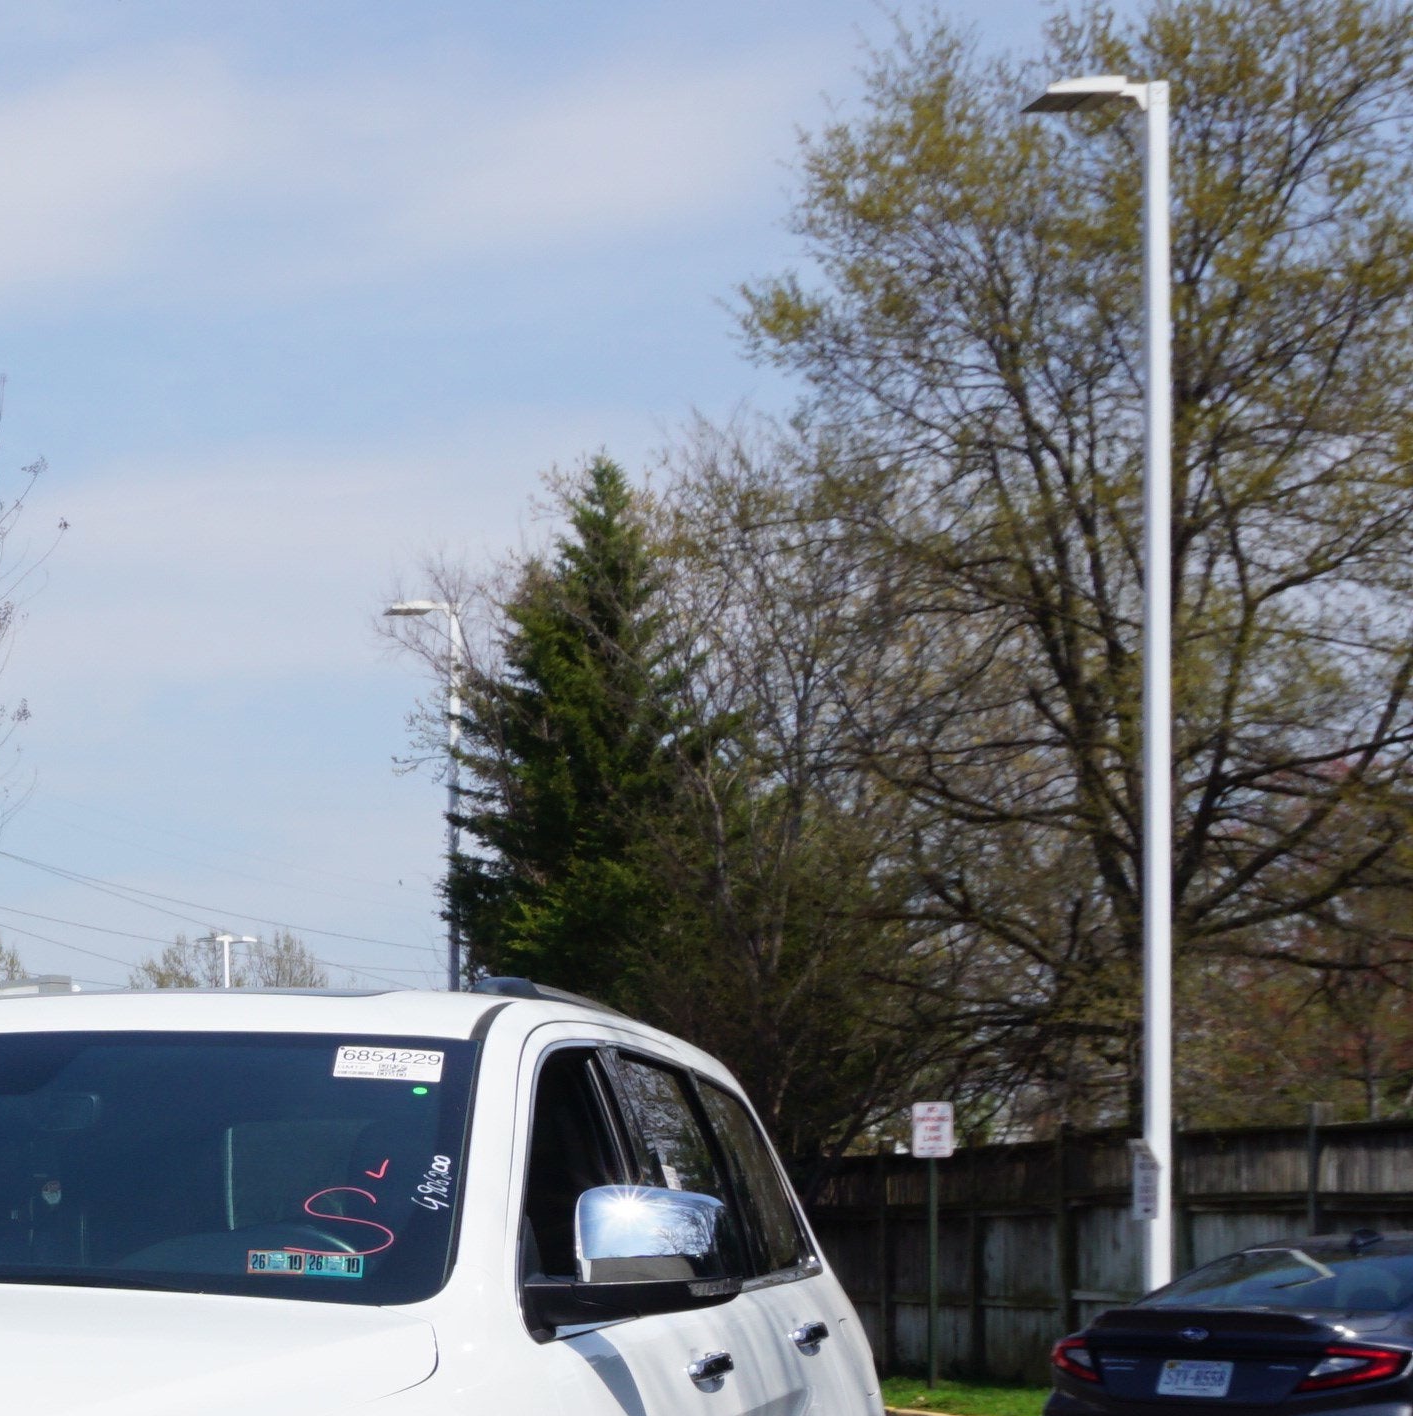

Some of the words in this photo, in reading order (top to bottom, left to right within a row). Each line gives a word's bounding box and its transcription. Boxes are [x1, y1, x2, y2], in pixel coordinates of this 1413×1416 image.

[342, 1048, 441, 1067] 6854229
[251, 1254, 266, 1270] 26
[309, 1254, 323, 1271] 26
